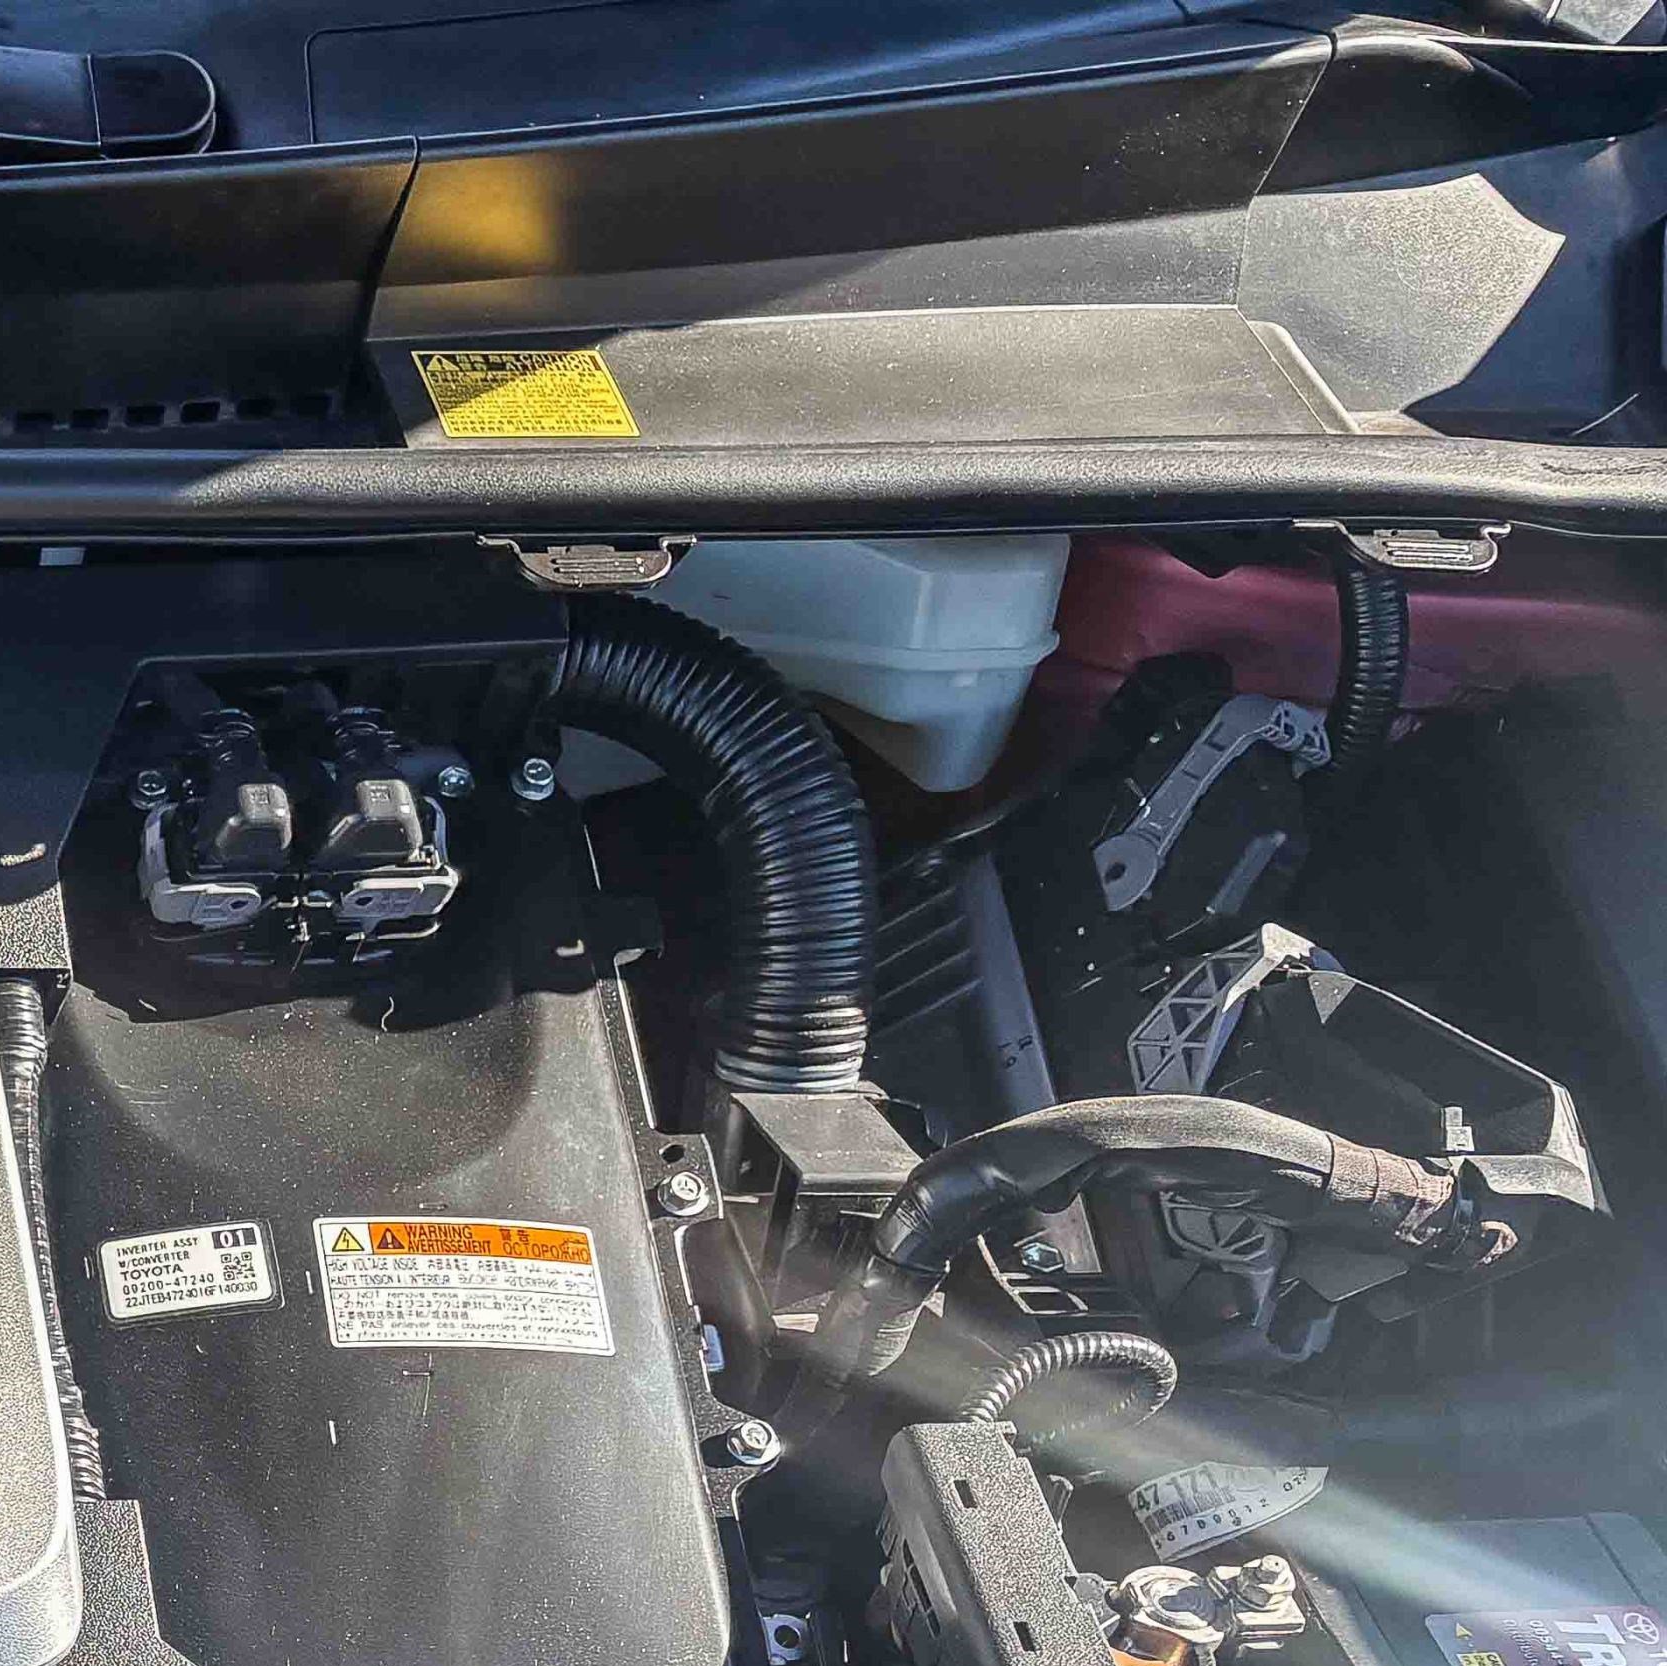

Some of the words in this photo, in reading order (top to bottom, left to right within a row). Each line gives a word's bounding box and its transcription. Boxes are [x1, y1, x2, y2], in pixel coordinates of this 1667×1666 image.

[519, 353, 591, 363] CAUTION
[506, 361, 594, 371] ATTENTION
[404, 1225, 473, 1240] WARNING
[115, 1240, 167, 1256] INVERTER
[172, 1237, 199, 1248] ASSY
[220, 1231, 247, 1249] 01
[408, 1239, 491, 1254] AVERTISSEMENT
[120, 1263, 183, 1281] TOYOTA
